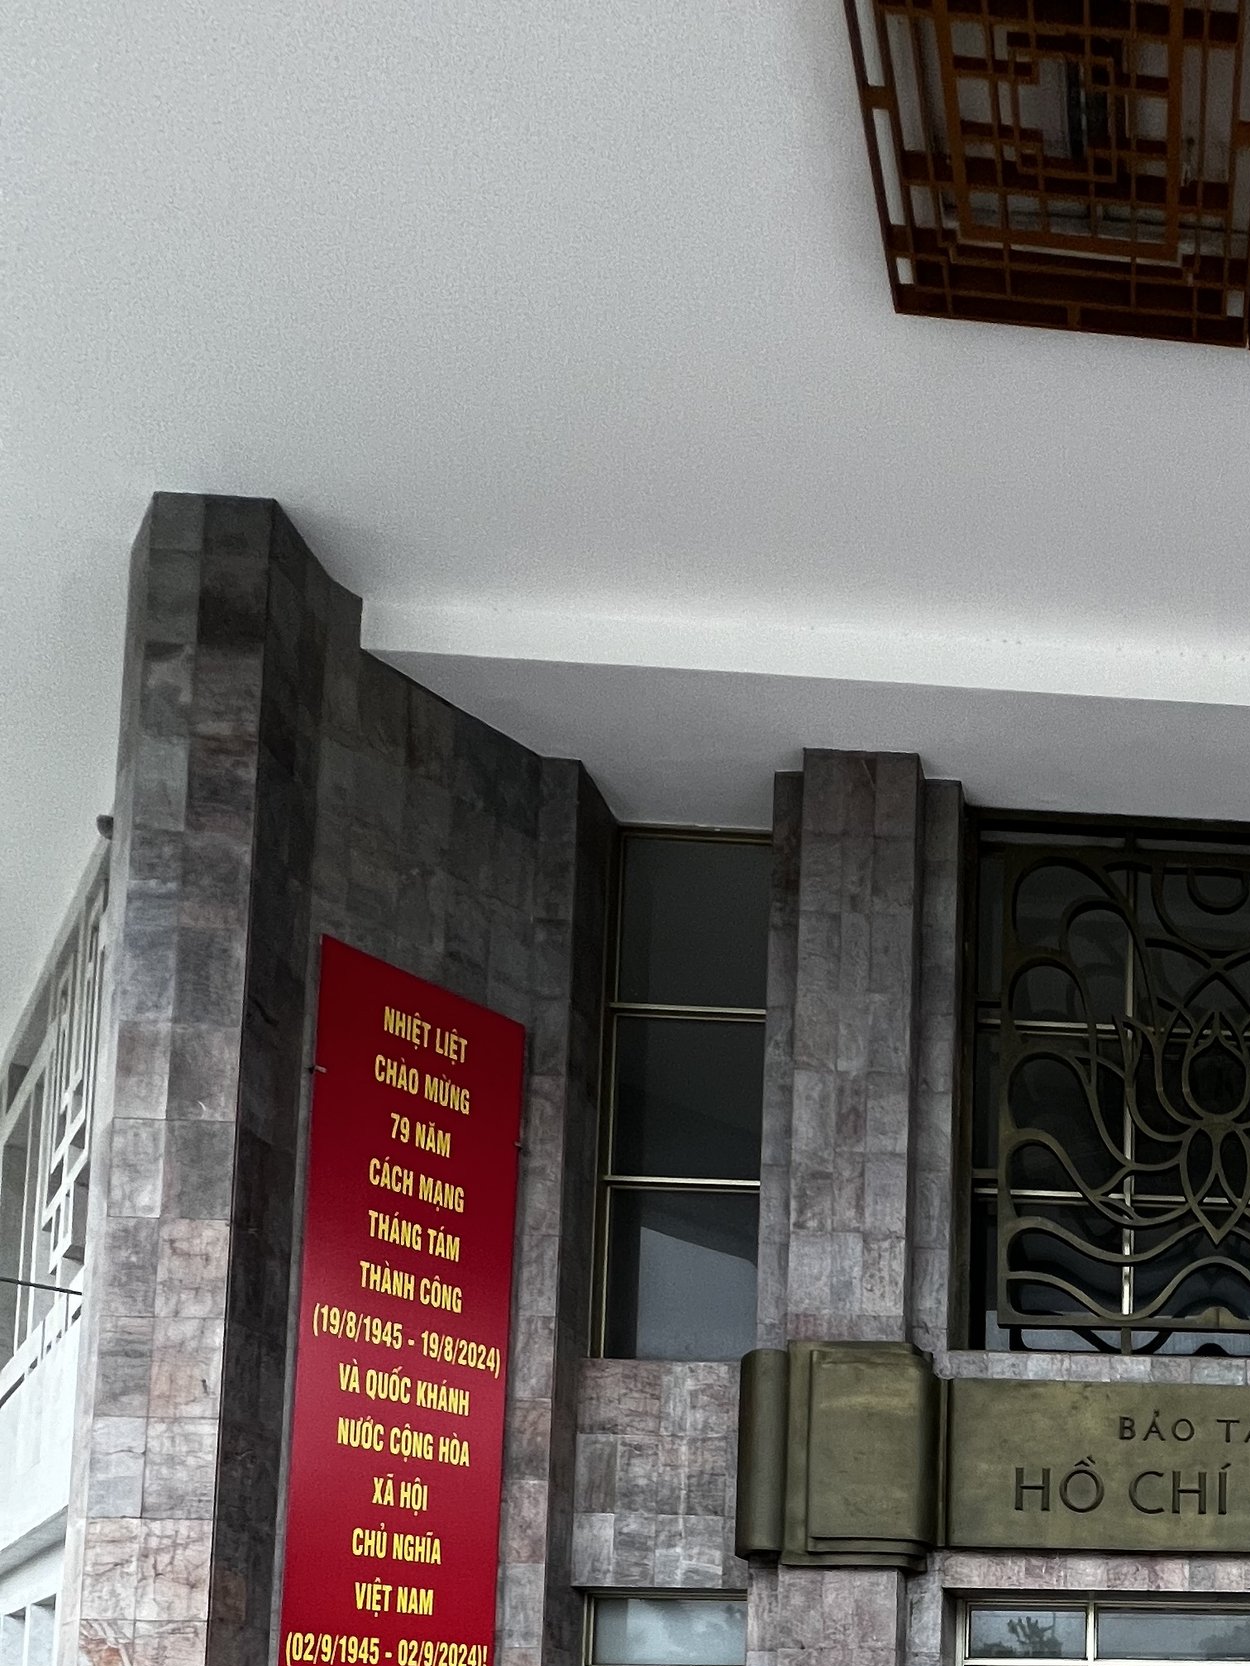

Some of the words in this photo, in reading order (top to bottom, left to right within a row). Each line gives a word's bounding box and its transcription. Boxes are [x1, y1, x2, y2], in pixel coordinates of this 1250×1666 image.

[384, 1005, 431, 1051] NHIỆT
[436, 1027, 467, 1064] LIỆT
[375, 1054, 418, 1095] CHÀO
[425, 1075, 469, 1114] MỪNG
[391, 1113, 409, 1143] 79
[416, 1121, 450, 1157] NĂM
[370, 1156, 413, 1197] CÁCH
[419, 1173, 464, 1212] MẠNG
[369, 1210, 422, 1251] THÁNG
[427, 1225, 460, 1262] TÁM
[360, 1259, 414, 1301] THÀNH
[420, 1275, 462, 1313] CÔNG
[313, 1302, 402, 1349] (19/8/1945
[421, 1330, 500, 1379] 19/8/2024)
[339, 1359, 360, 1393] VÀ
[366, 1366, 411, 1404] QUỐC
[416, 1380, 469, 1416] KHÁNH
[337, 1416, 384, 1451] NƯỚC
[390, 1424, 433, 1461] CỘNG
[439, 1433, 469, 1467] HÒA
[1118, 1409, 1195, 1442] BẢO
[372, 1474, 394, 1506] XÃ
[400, 1477, 427, 1515] HỘI
[1013, 1455, 1105, 1513] HỒ
[1128, 1462, 1231, 1515] CHÍ
[352, 1521, 387, 1558] CHỦ
[393, 1532, 441, 1565] NGHĨA
[355, 1577, 392, 1616] VIỆT
[397, 1584, 433, 1615] NAM
[286, 1632, 379, 1666] (02/9/1945
